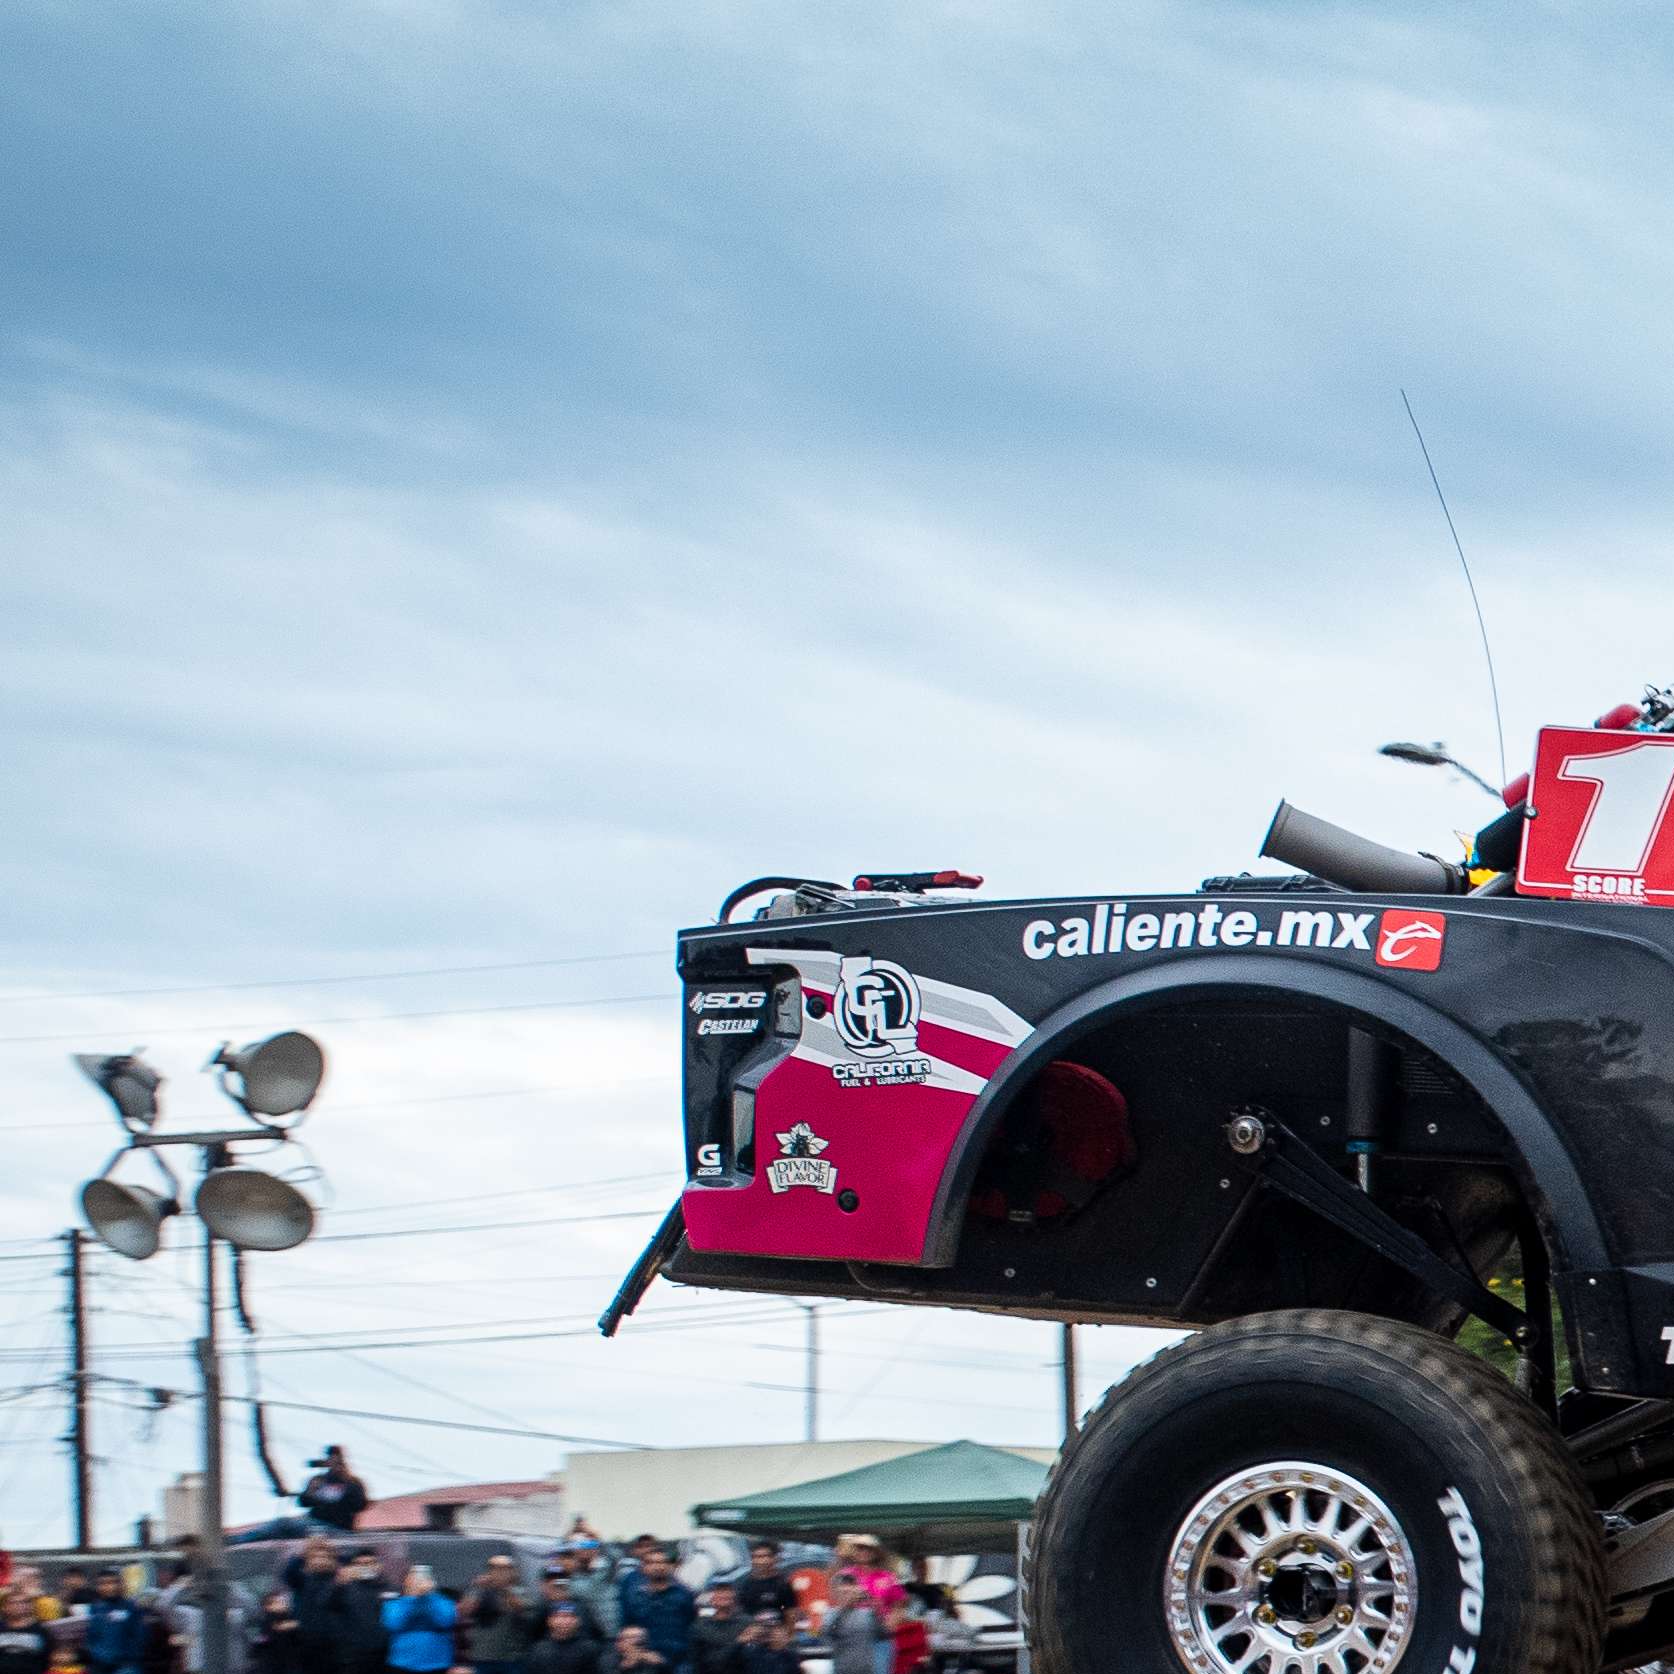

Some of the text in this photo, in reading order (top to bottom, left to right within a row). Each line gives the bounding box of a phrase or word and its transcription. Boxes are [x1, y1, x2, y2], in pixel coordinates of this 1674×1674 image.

[1572, 874, 1646, 896] SCORE
[1022, 903, 1376, 960] caliente.mx
[833, 1060, 931, 1079] CALIFORNIA
[697, 1144, 721, 1166] G
[776, 1161, 828, 1175] DIVINE
[779, 1173, 825, 1185] FLAVOR
[1436, 1485, 1485, 1636] TOYO
